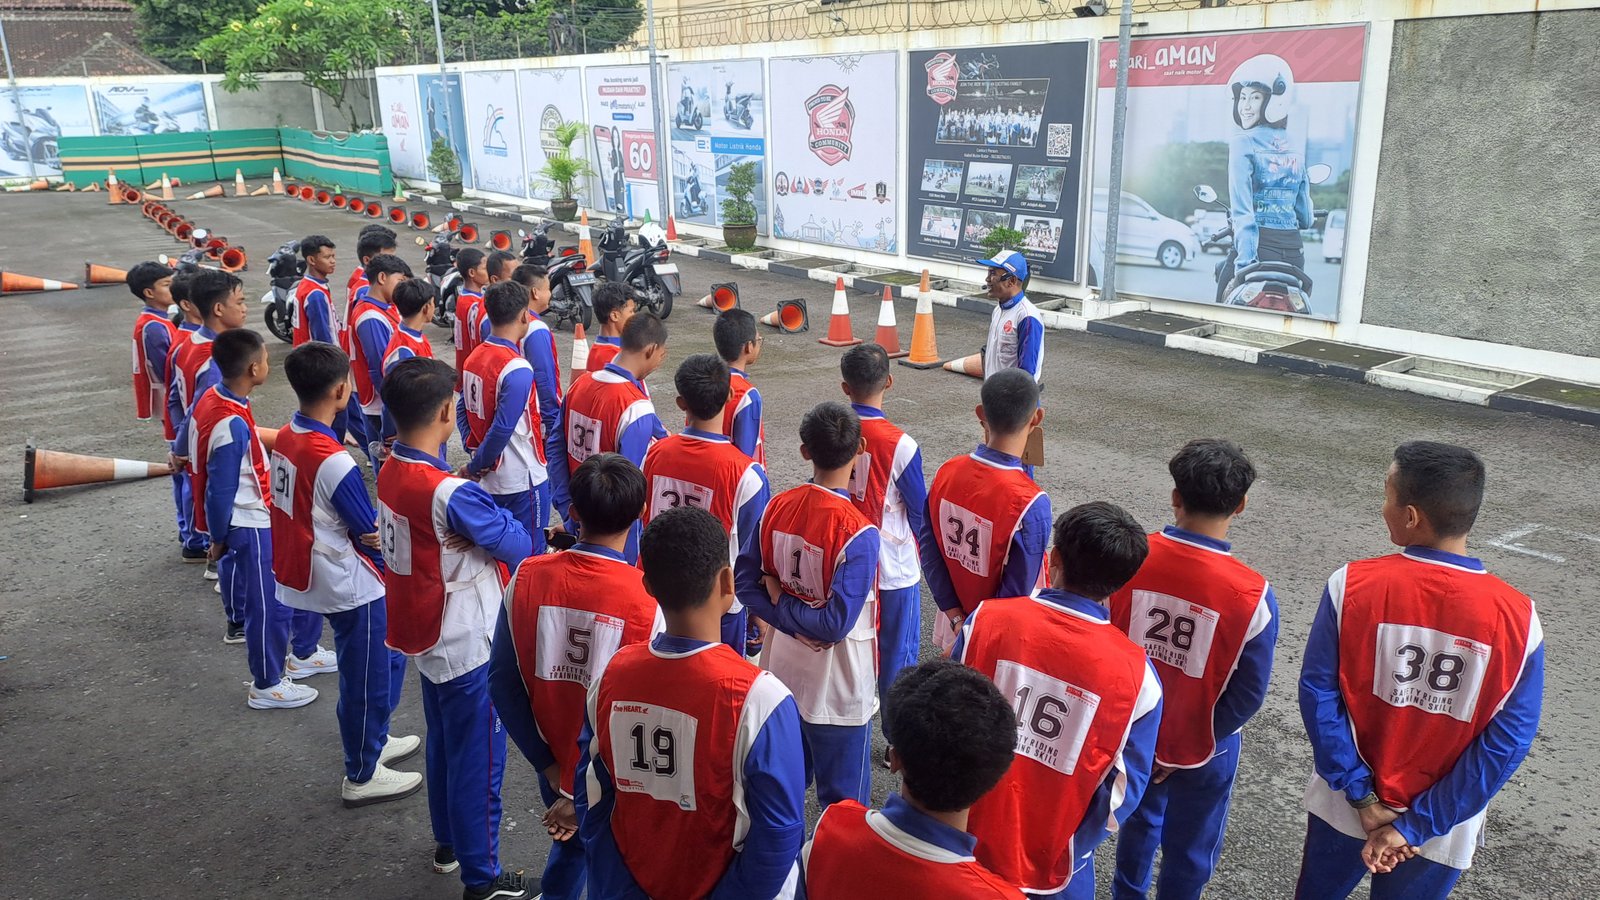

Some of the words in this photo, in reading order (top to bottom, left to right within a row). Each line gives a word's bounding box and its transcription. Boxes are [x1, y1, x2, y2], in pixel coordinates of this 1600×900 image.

[814, 139, 848, 152] COMMUNITY
[815, 128, 849, 136] HONDA
[629, 141, 652, 171] 60
[276, 466, 290, 498] 31
[946, 515, 980, 559] 34
[791, 548, 802, 581] 1
[1143, 606, 1195, 653] 28
[565, 625, 592, 667] 5
[552, 665, 578, 674] SAFETY
[1392, 642, 1467, 694] 38
[1015, 684, 1070, 741] 16
[1389, 694, 1425, 706] TRANING
[1427, 702, 1453, 714] SKILL
[1422, 691, 1453, 705] RIDING
[630, 722, 678, 778] 19
[1030, 738, 1059, 757] RIDING
[1033, 749, 1057, 766] SKILL
